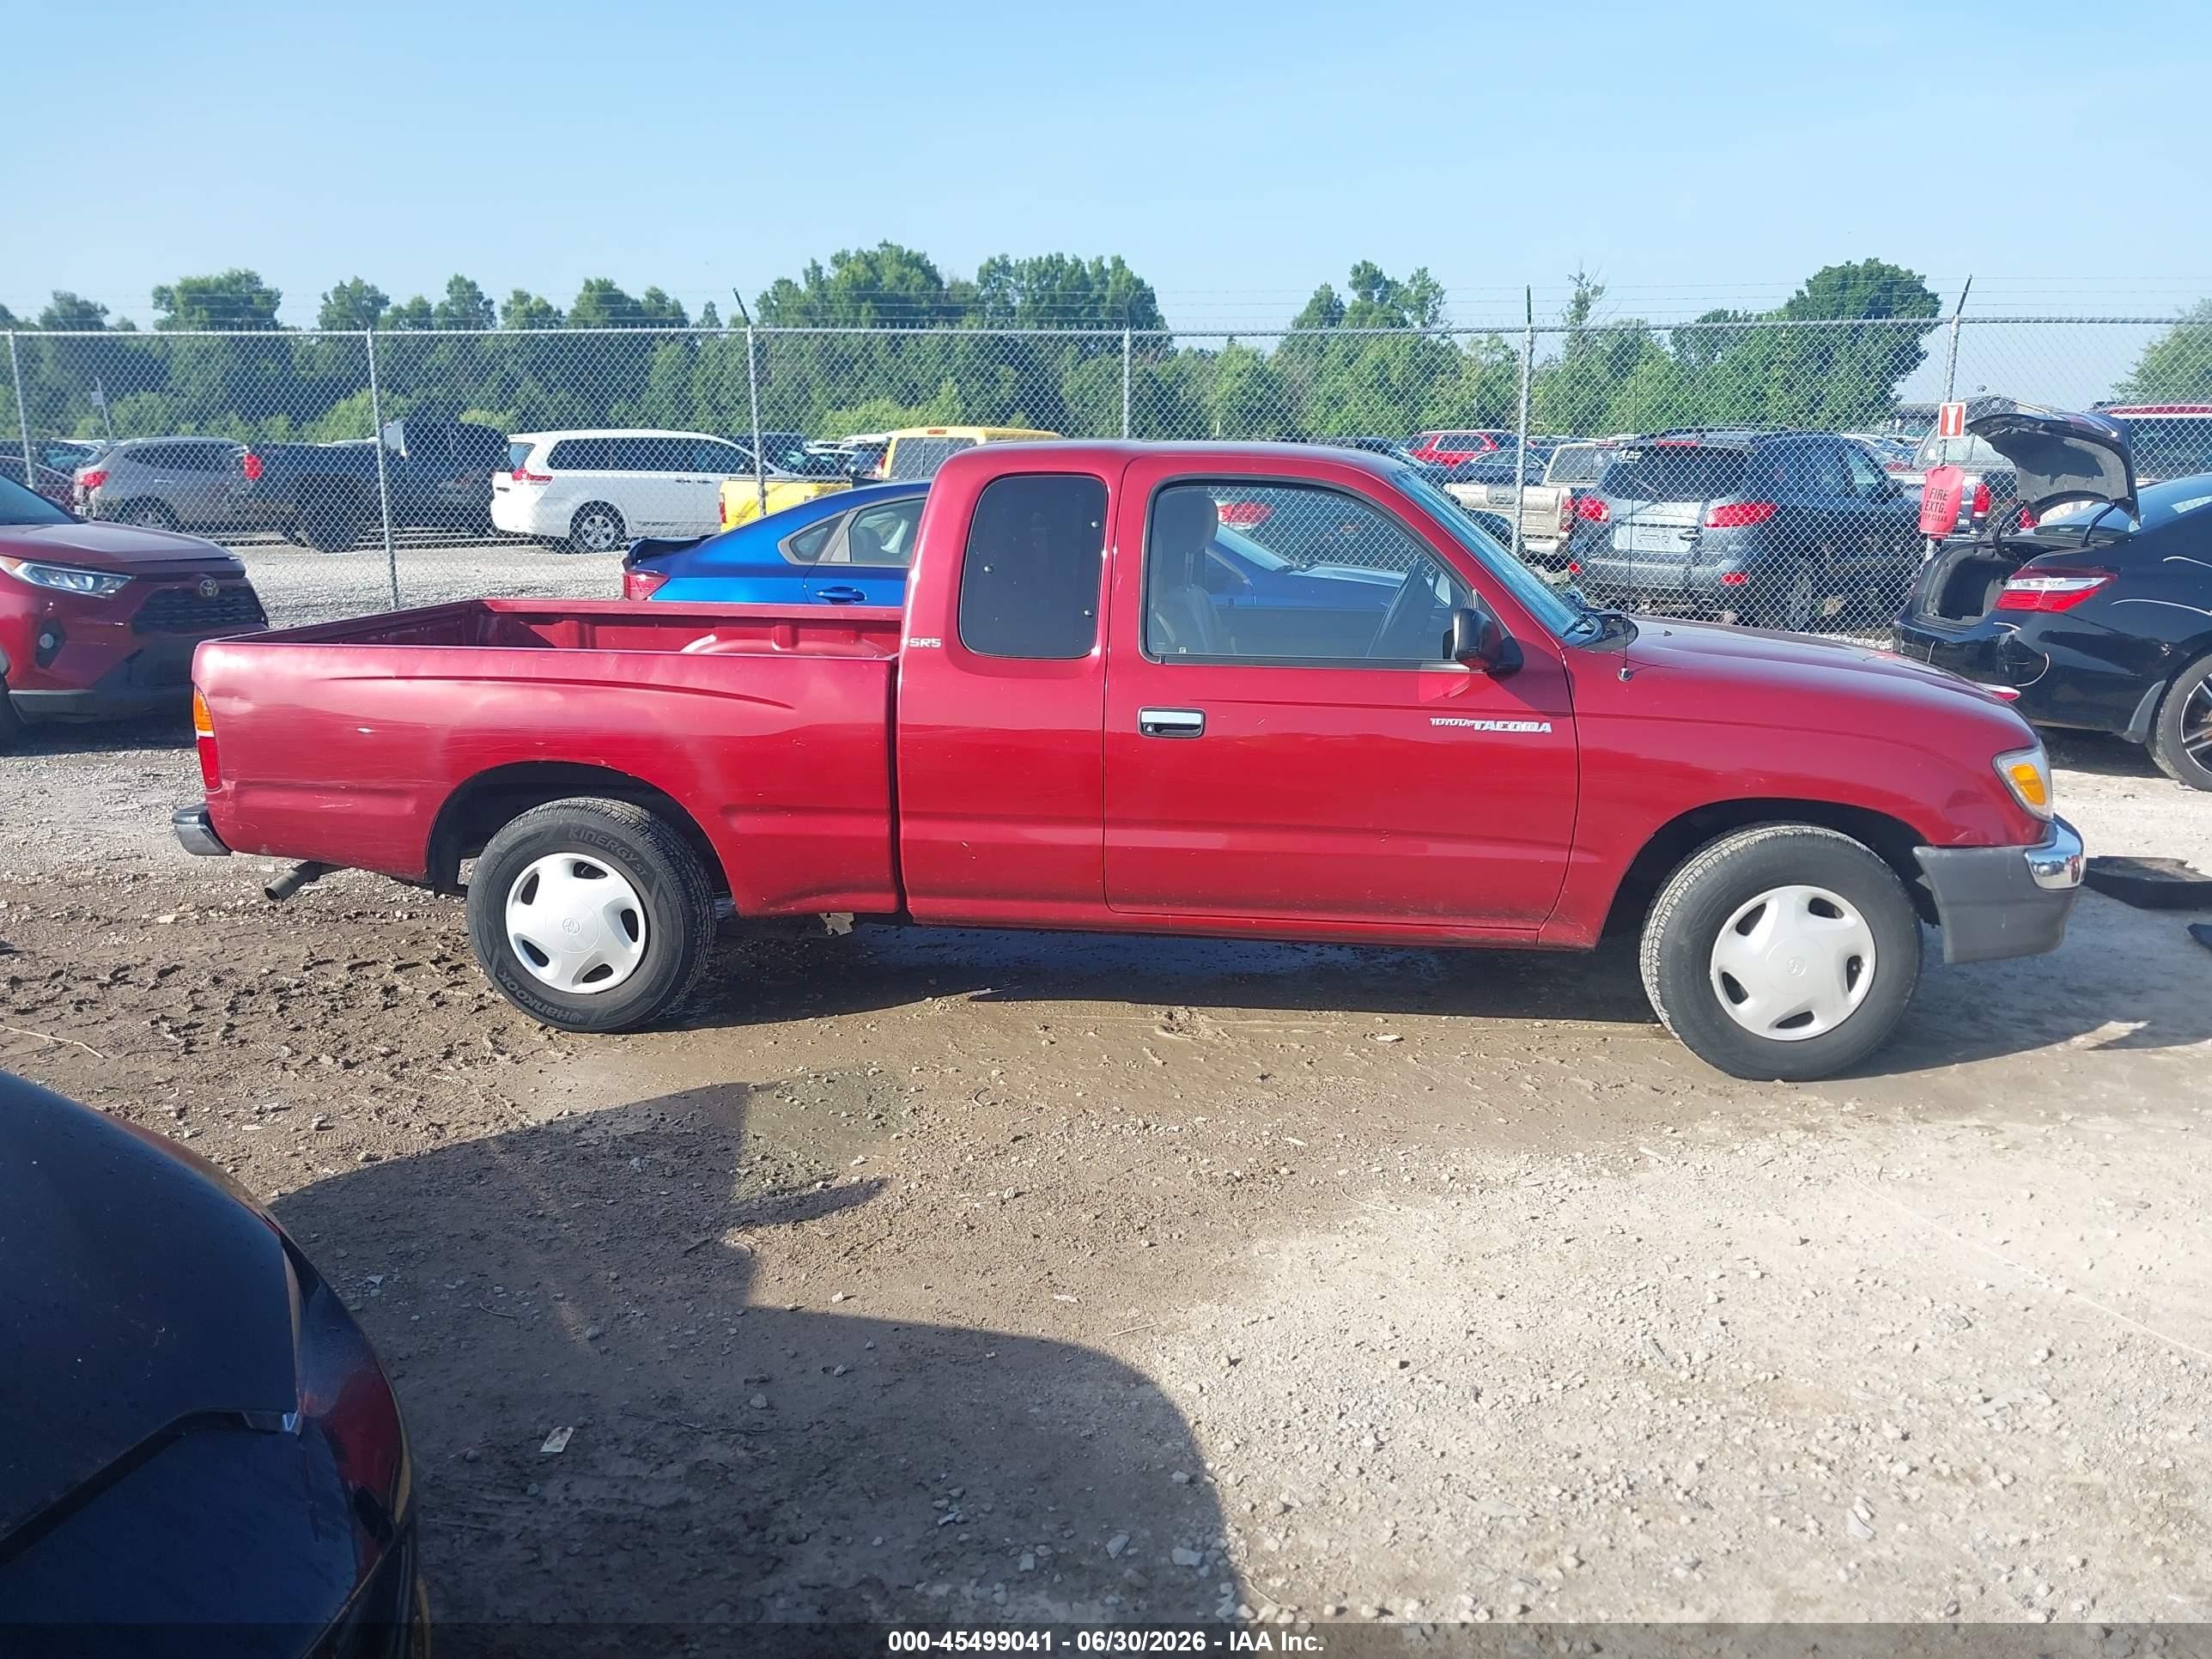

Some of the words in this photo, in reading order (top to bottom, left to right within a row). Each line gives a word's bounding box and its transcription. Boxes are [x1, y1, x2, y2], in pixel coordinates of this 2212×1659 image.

[1929, 488, 1949, 501] FIRE
[1924, 501, 1947, 514] EXTG.
[1430, 717, 1472, 727] TOYOTA
[1473, 720, 1553, 733] TACOMA
